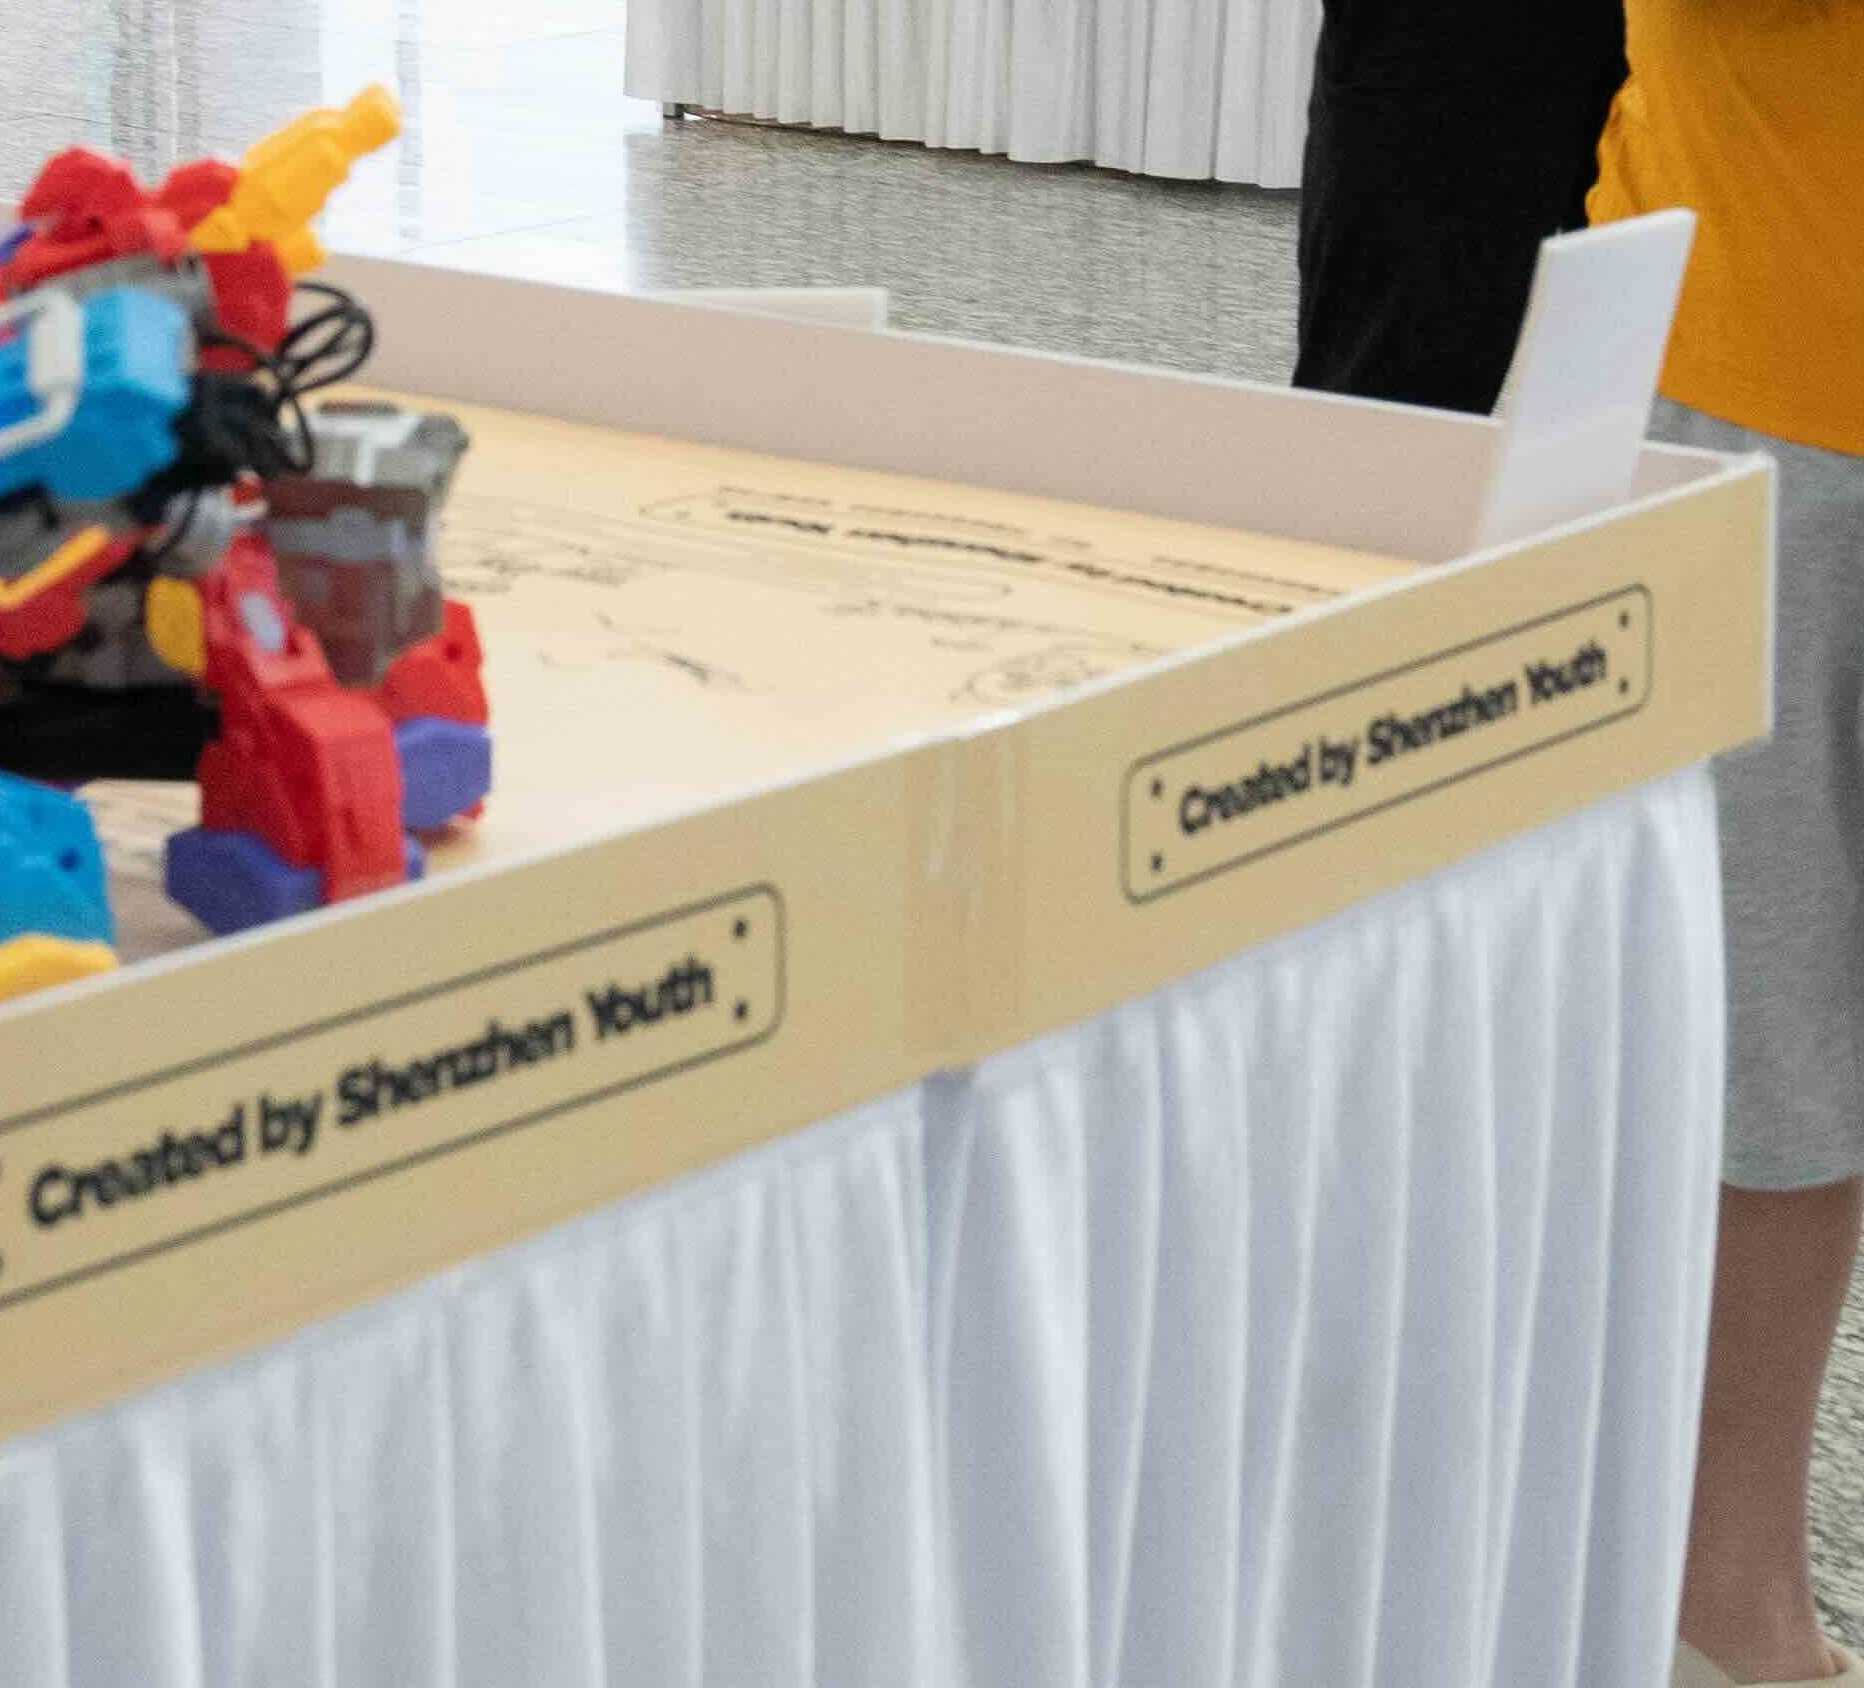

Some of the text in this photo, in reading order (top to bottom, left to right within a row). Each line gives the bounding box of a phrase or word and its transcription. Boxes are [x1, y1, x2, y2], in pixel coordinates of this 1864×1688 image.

[1177, 639, 1608, 835] Created by Shenzhen Youth
[28, 954, 715, 1229] Created by Shenzhen Youth
